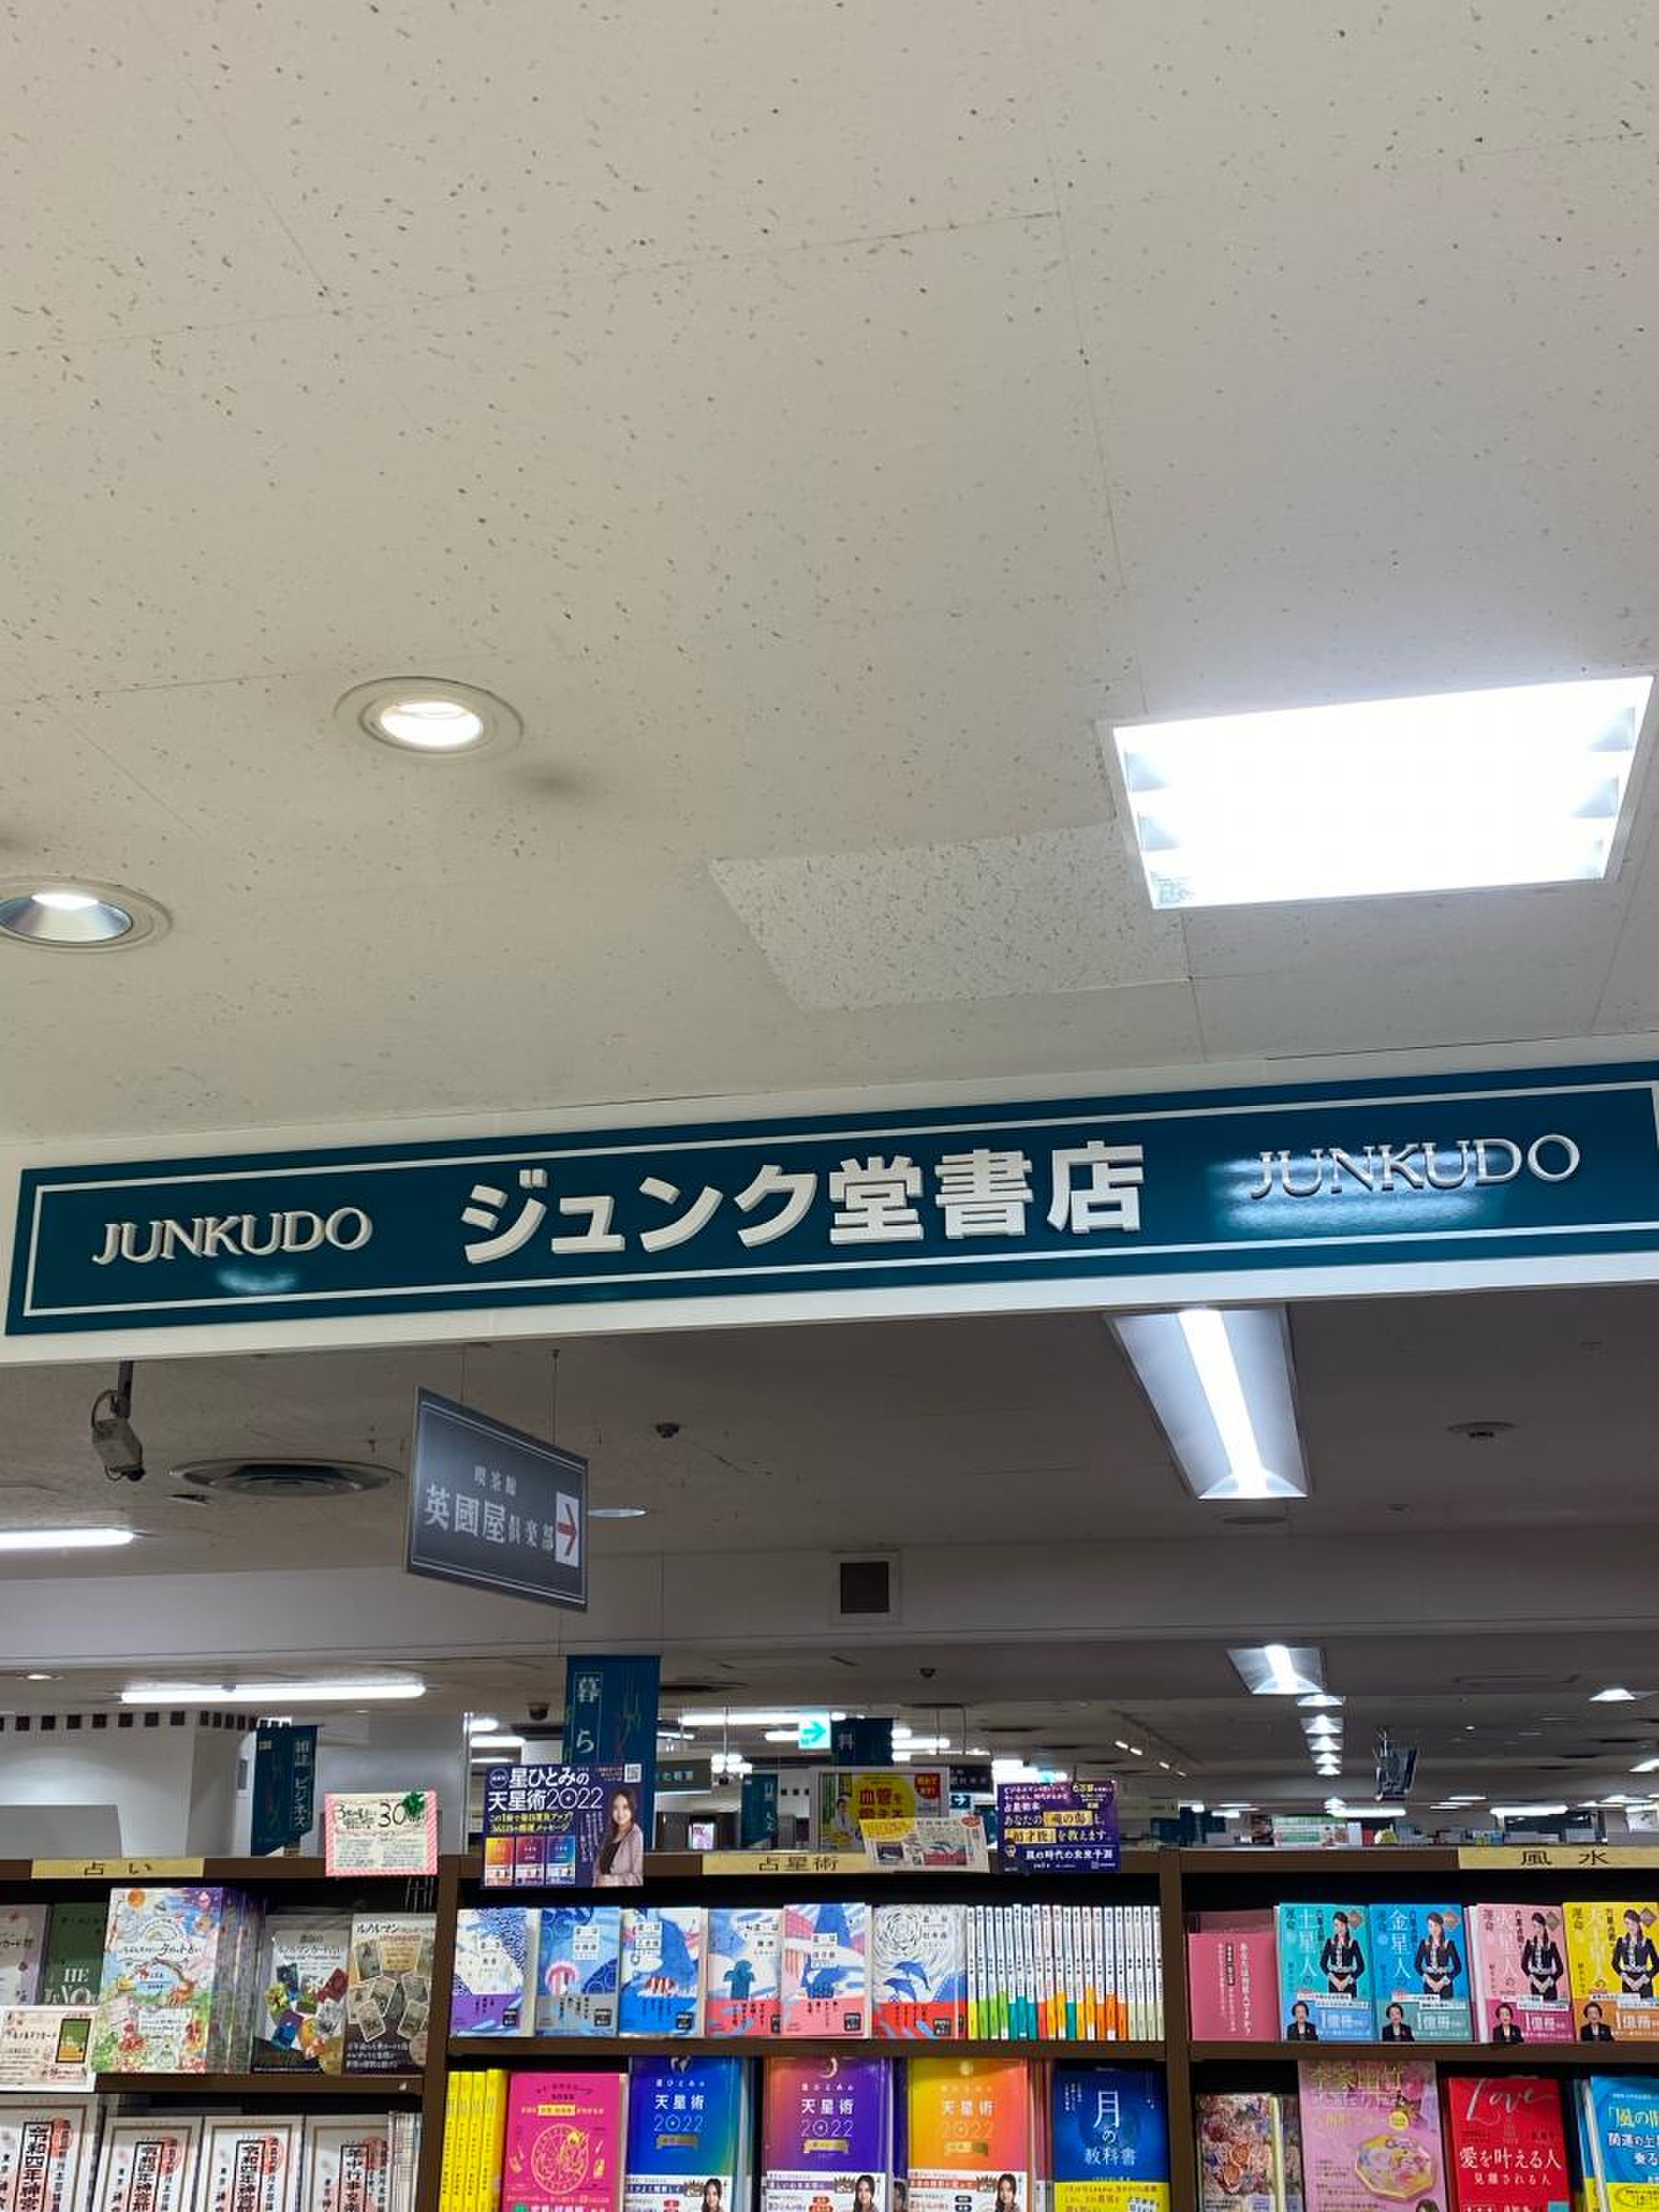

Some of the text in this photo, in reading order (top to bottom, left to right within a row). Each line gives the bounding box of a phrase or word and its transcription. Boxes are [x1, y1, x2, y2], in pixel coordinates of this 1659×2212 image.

[1251, 1134, 1581, 1201] JUNKUDO
[462, 1140, 1145, 1265] ジュンク堂書店
[91, 1206, 374, 1267] JUNKUDO
[509, 1766, 590, 1790] 星ひとみの
[488, 1786, 605, 1812] 天星術2022
[758, 1855, 839, 1874] 占星術
[1520, 1849, 1609, 1867] 風水
[83, 1862, 152, 1877] 占い
[653, 2094, 705, 2111] 天星術
[800, 2098, 854, 2116] 天星術
[941, 2100, 995, 2117] 天星術
[653, 2113, 704, 2133] 2022
[800, 2119, 853, 2137] 2022
[1460, 2146, 1562, 2170] 愛を叶える人
